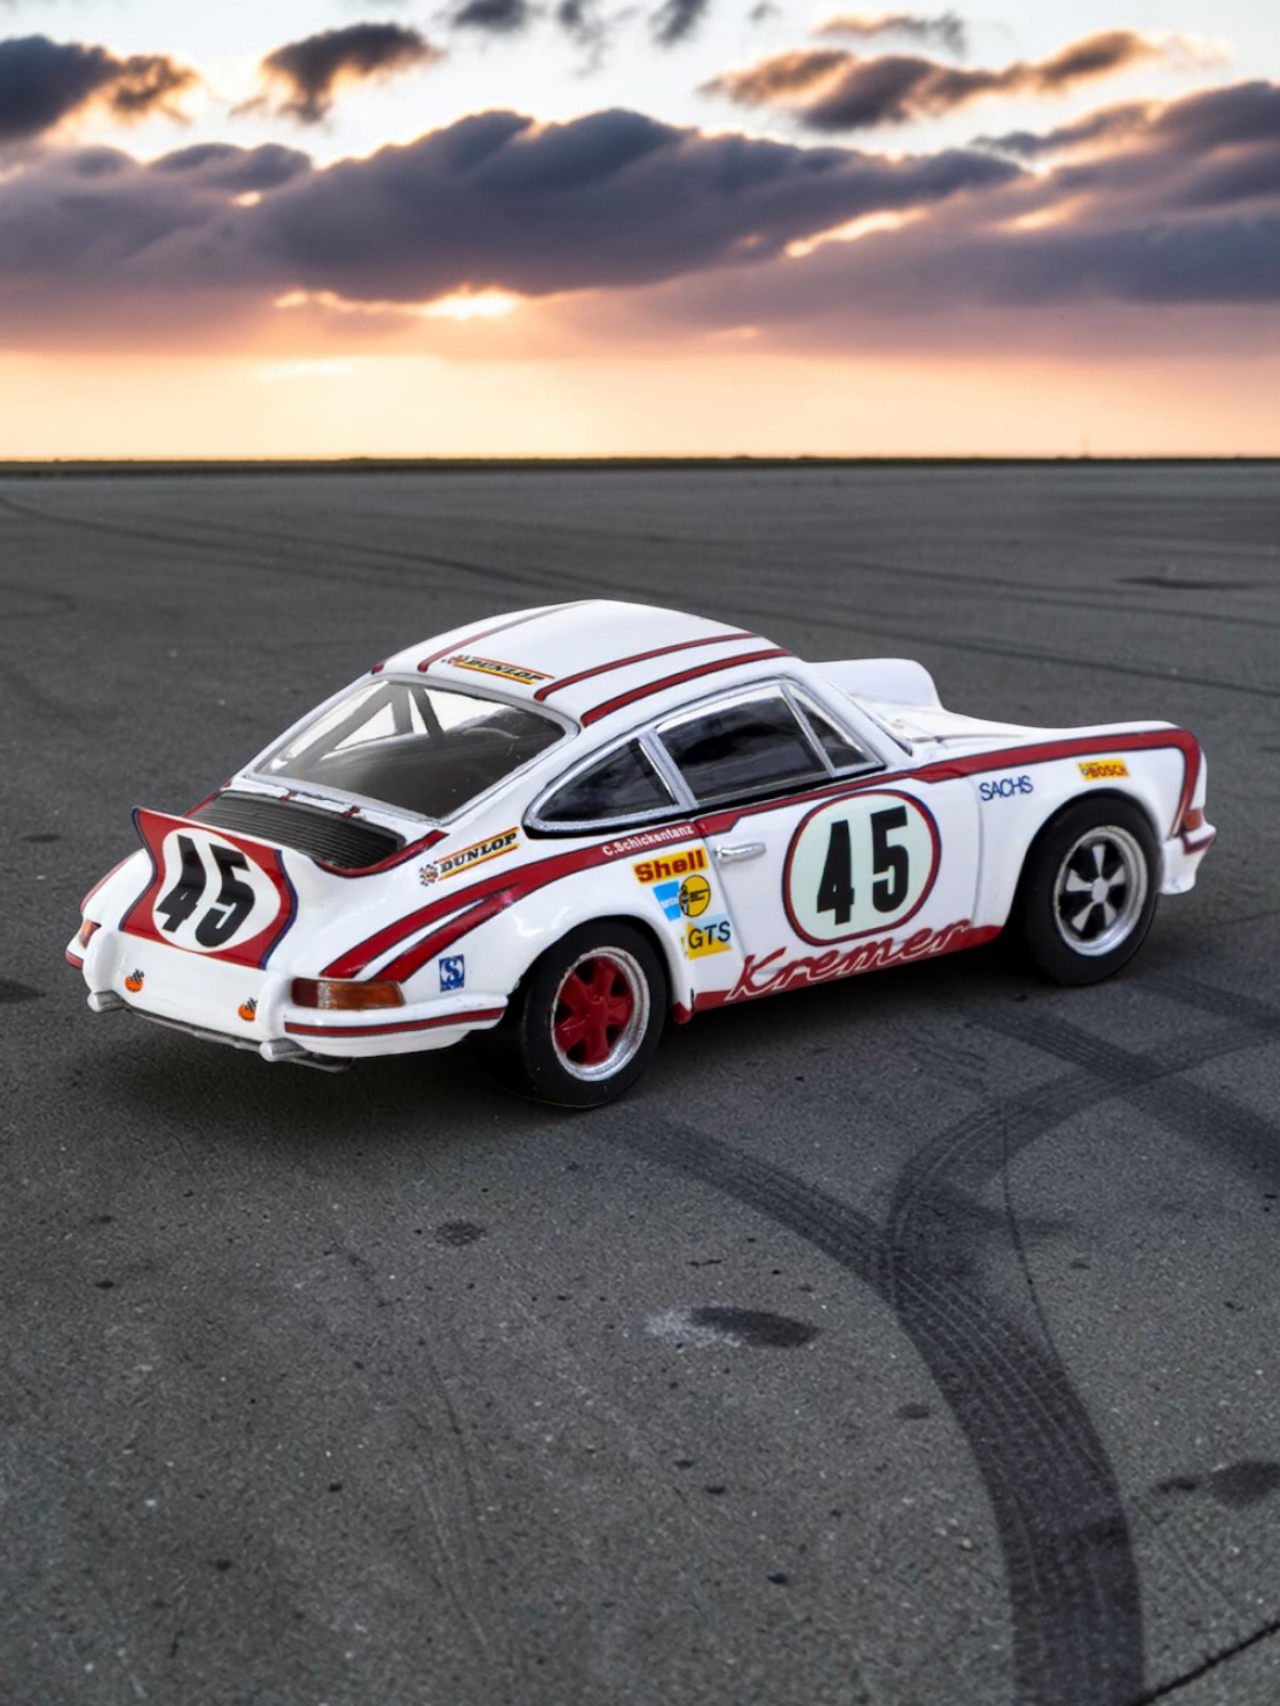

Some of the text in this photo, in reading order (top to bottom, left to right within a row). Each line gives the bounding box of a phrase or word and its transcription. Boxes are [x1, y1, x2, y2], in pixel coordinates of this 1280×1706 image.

[979, 775, 1034, 801] SACHS
[1089, 764, 1129, 778] BOSCH
[440, 832, 518, 873] DUNLOP
[634, 849, 705, 882] Shell
[815, 805, 910, 926] 45
[155, 834, 256, 948] 45
[688, 920, 731, 949] GTS
[724, 918, 972, 1001] Kremer
